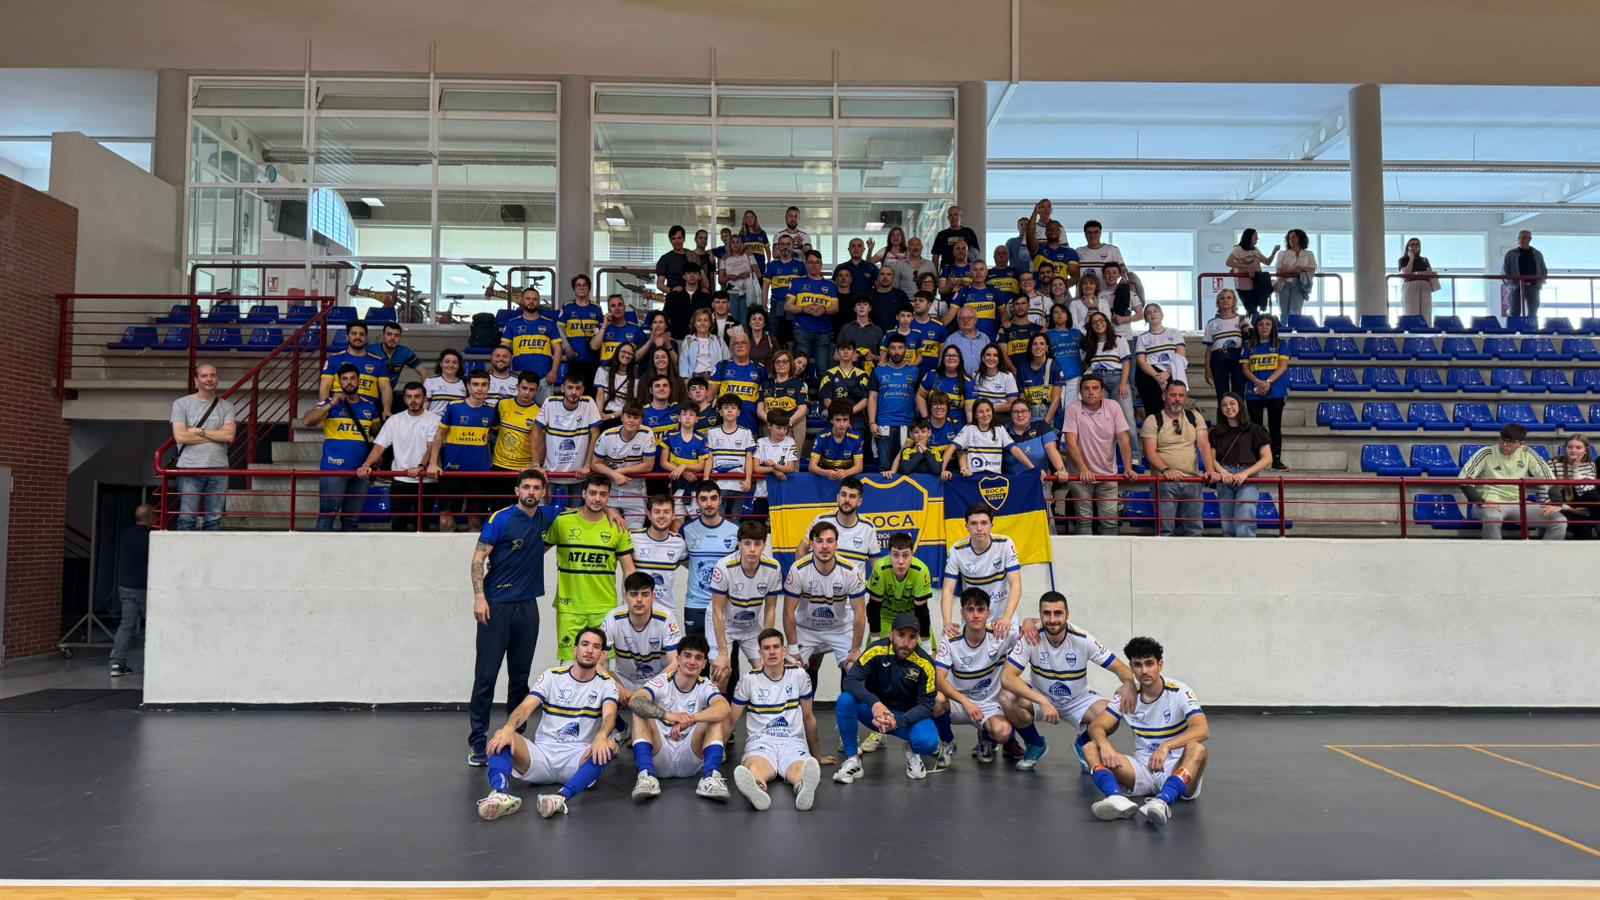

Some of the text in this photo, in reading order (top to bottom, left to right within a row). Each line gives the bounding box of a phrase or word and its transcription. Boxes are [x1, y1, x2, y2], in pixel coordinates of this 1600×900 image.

[519, 339, 548, 348] ATLEET
[865, 514, 914, 529] OCA
[567, 551, 610, 564] ATLEET
